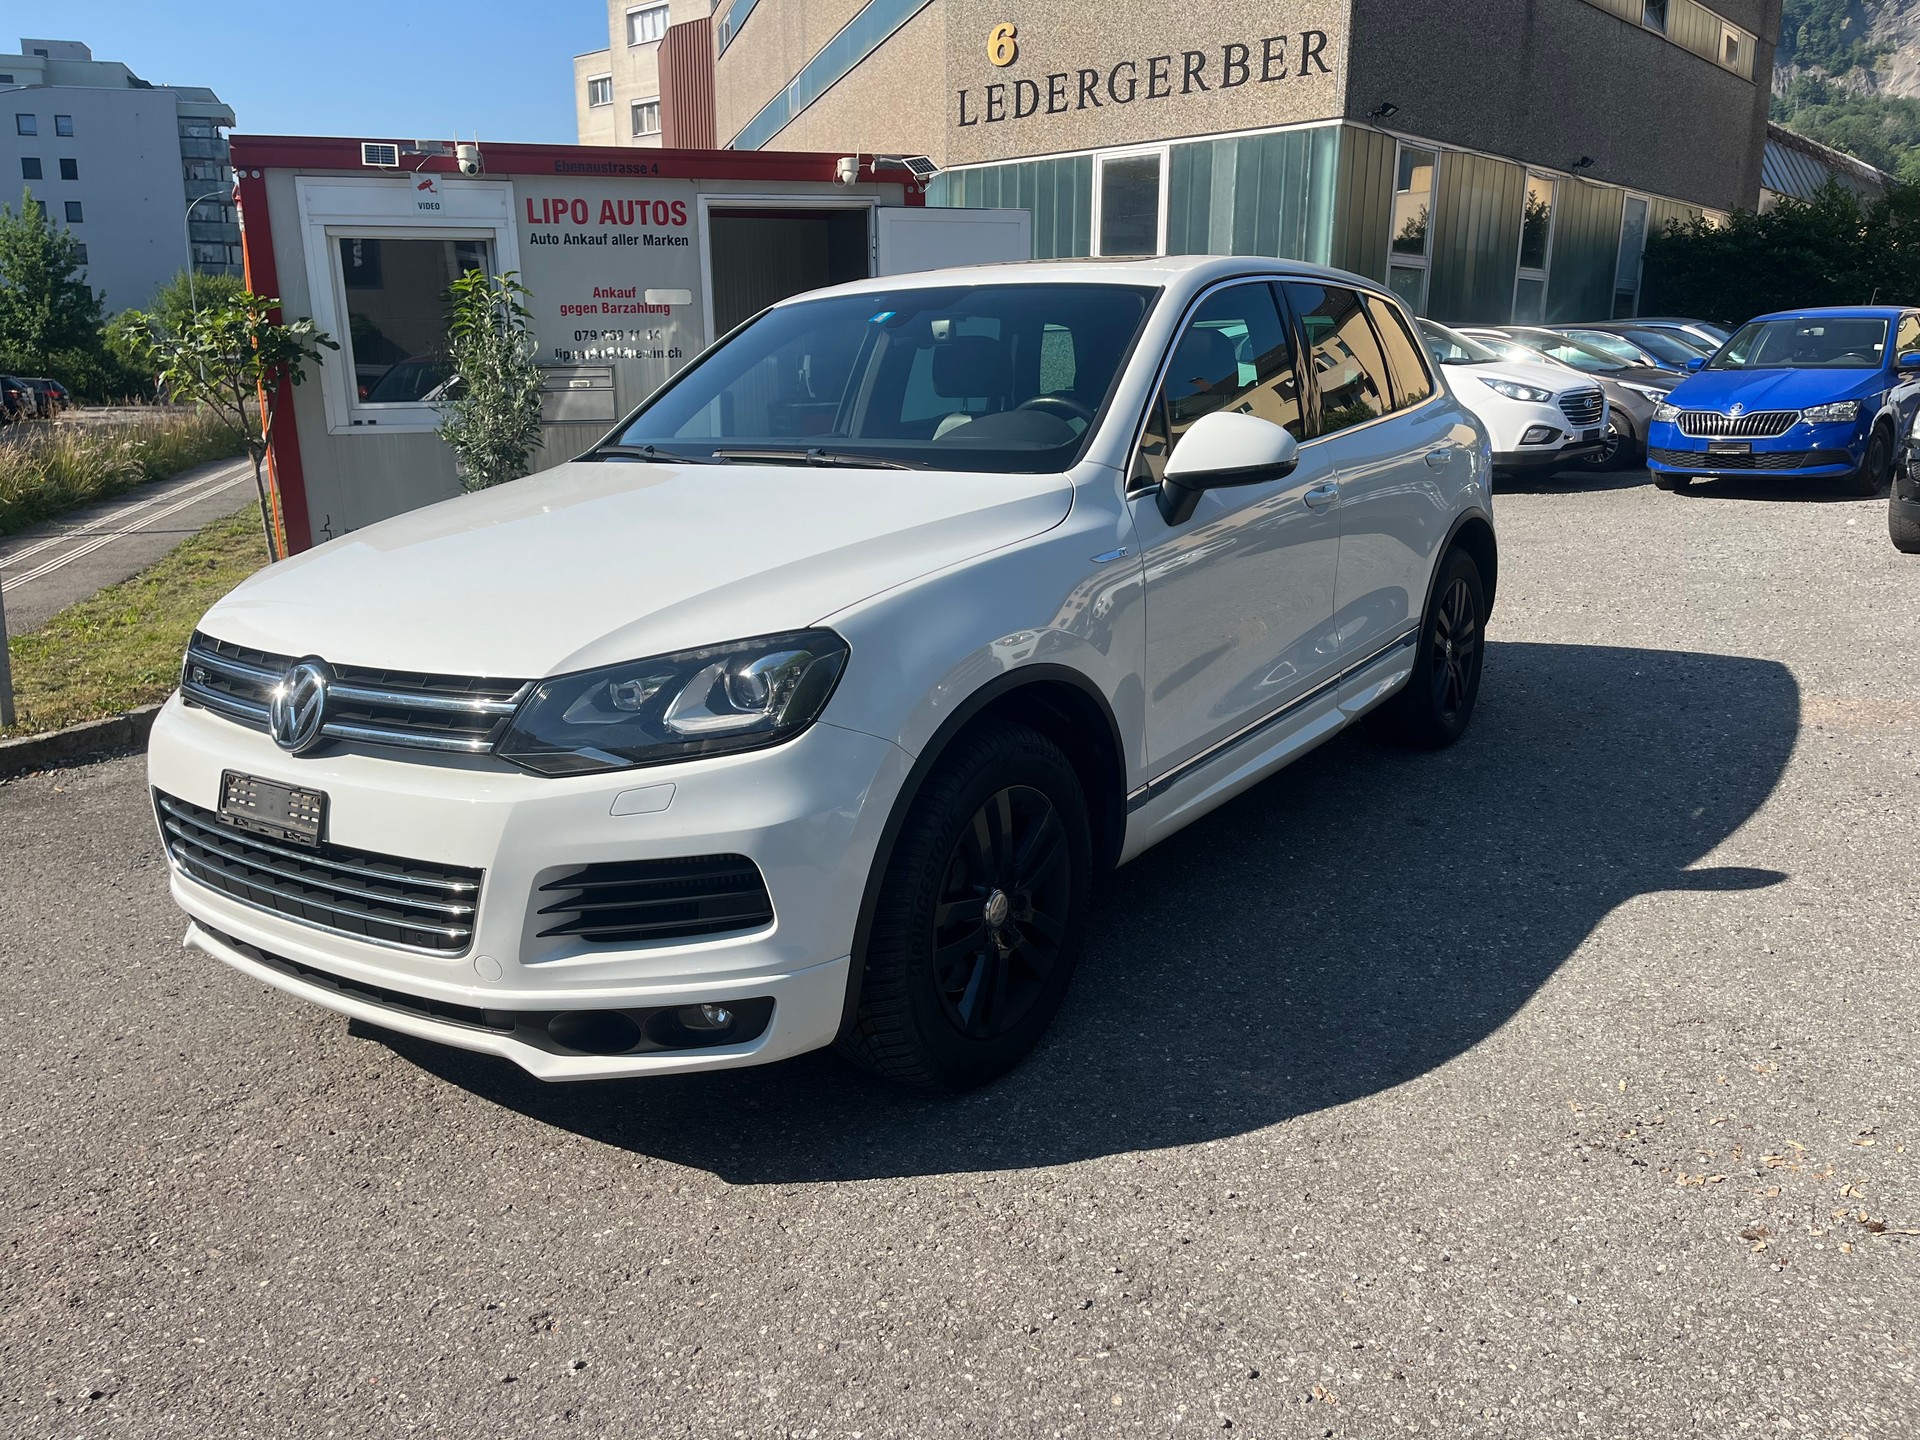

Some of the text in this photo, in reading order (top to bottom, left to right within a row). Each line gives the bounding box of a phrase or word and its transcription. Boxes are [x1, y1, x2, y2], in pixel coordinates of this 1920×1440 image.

[987, 22, 1018, 67] 6
[957, 29, 1333, 127] LEDERGERBER
[554, 160, 659, 175] Ebenaustrasse 4
[417, 202, 440, 210] VIDEO
[526, 198, 687, 226] LIPO AUTOS
[530, 232, 689, 246] Auto Ankauf aller Marken
[593, 287, 637, 298] Ankauf
[560, 302, 671, 316] gegen Barzahlung
[574, 330, 597, 341] 079
